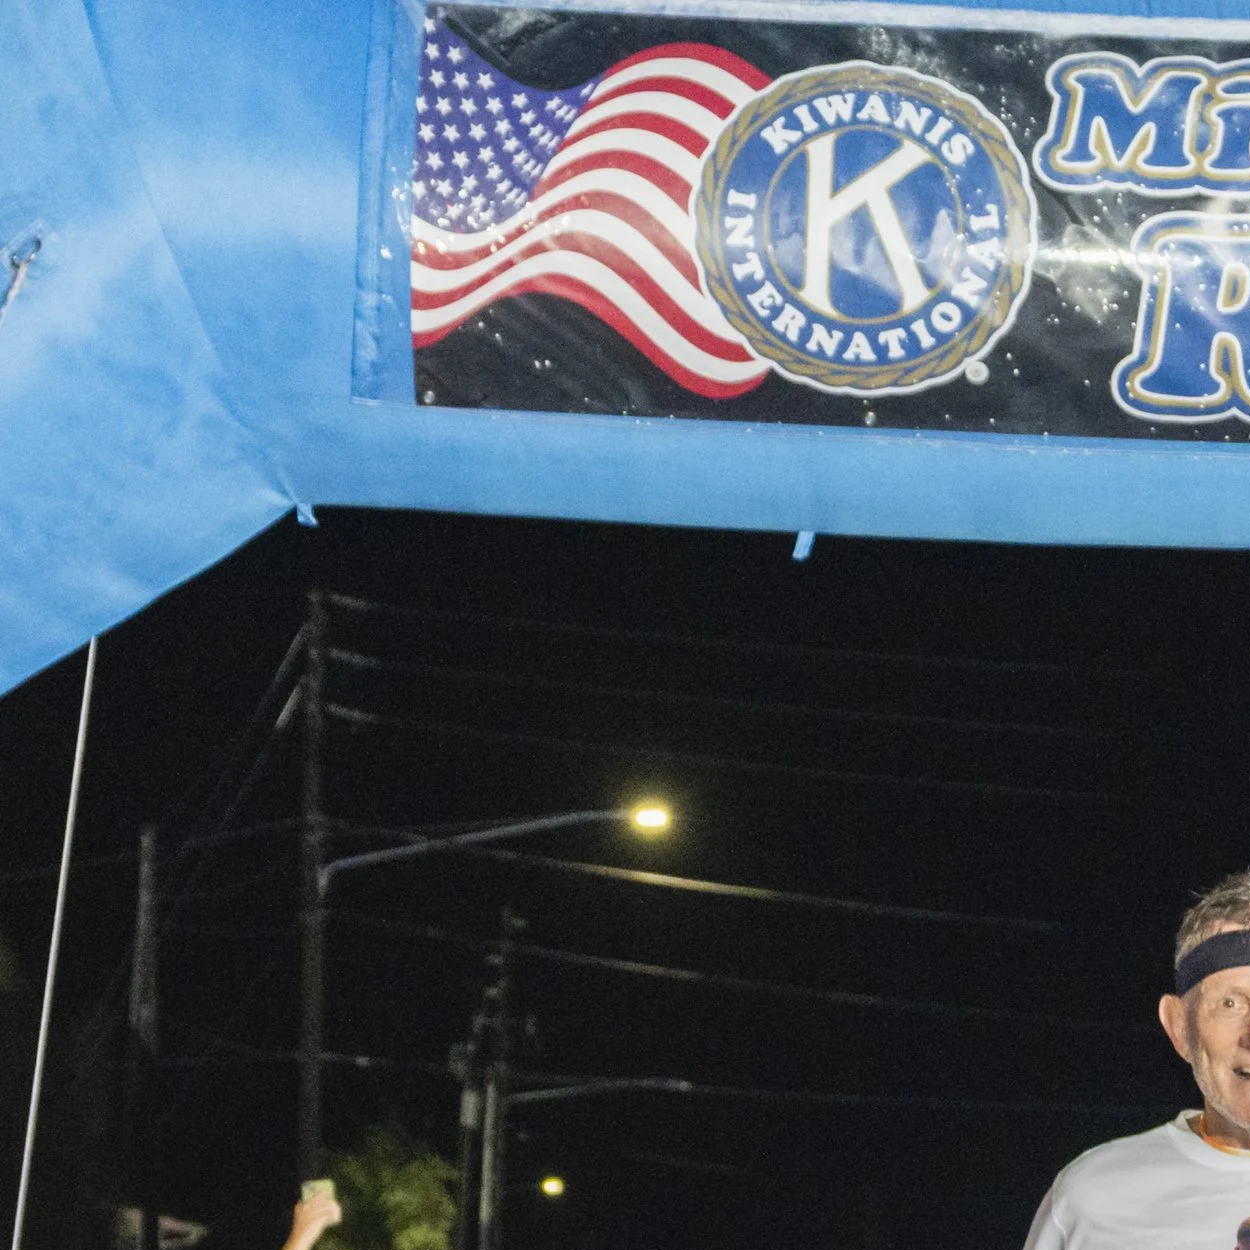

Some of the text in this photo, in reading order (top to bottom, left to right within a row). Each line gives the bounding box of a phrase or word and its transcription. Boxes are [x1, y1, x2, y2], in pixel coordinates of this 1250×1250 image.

[760, 92, 975, 167] KIWANIS
[725, 188, 1002, 363] INTERNATIONAL
[797, 131, 934, 318] K
